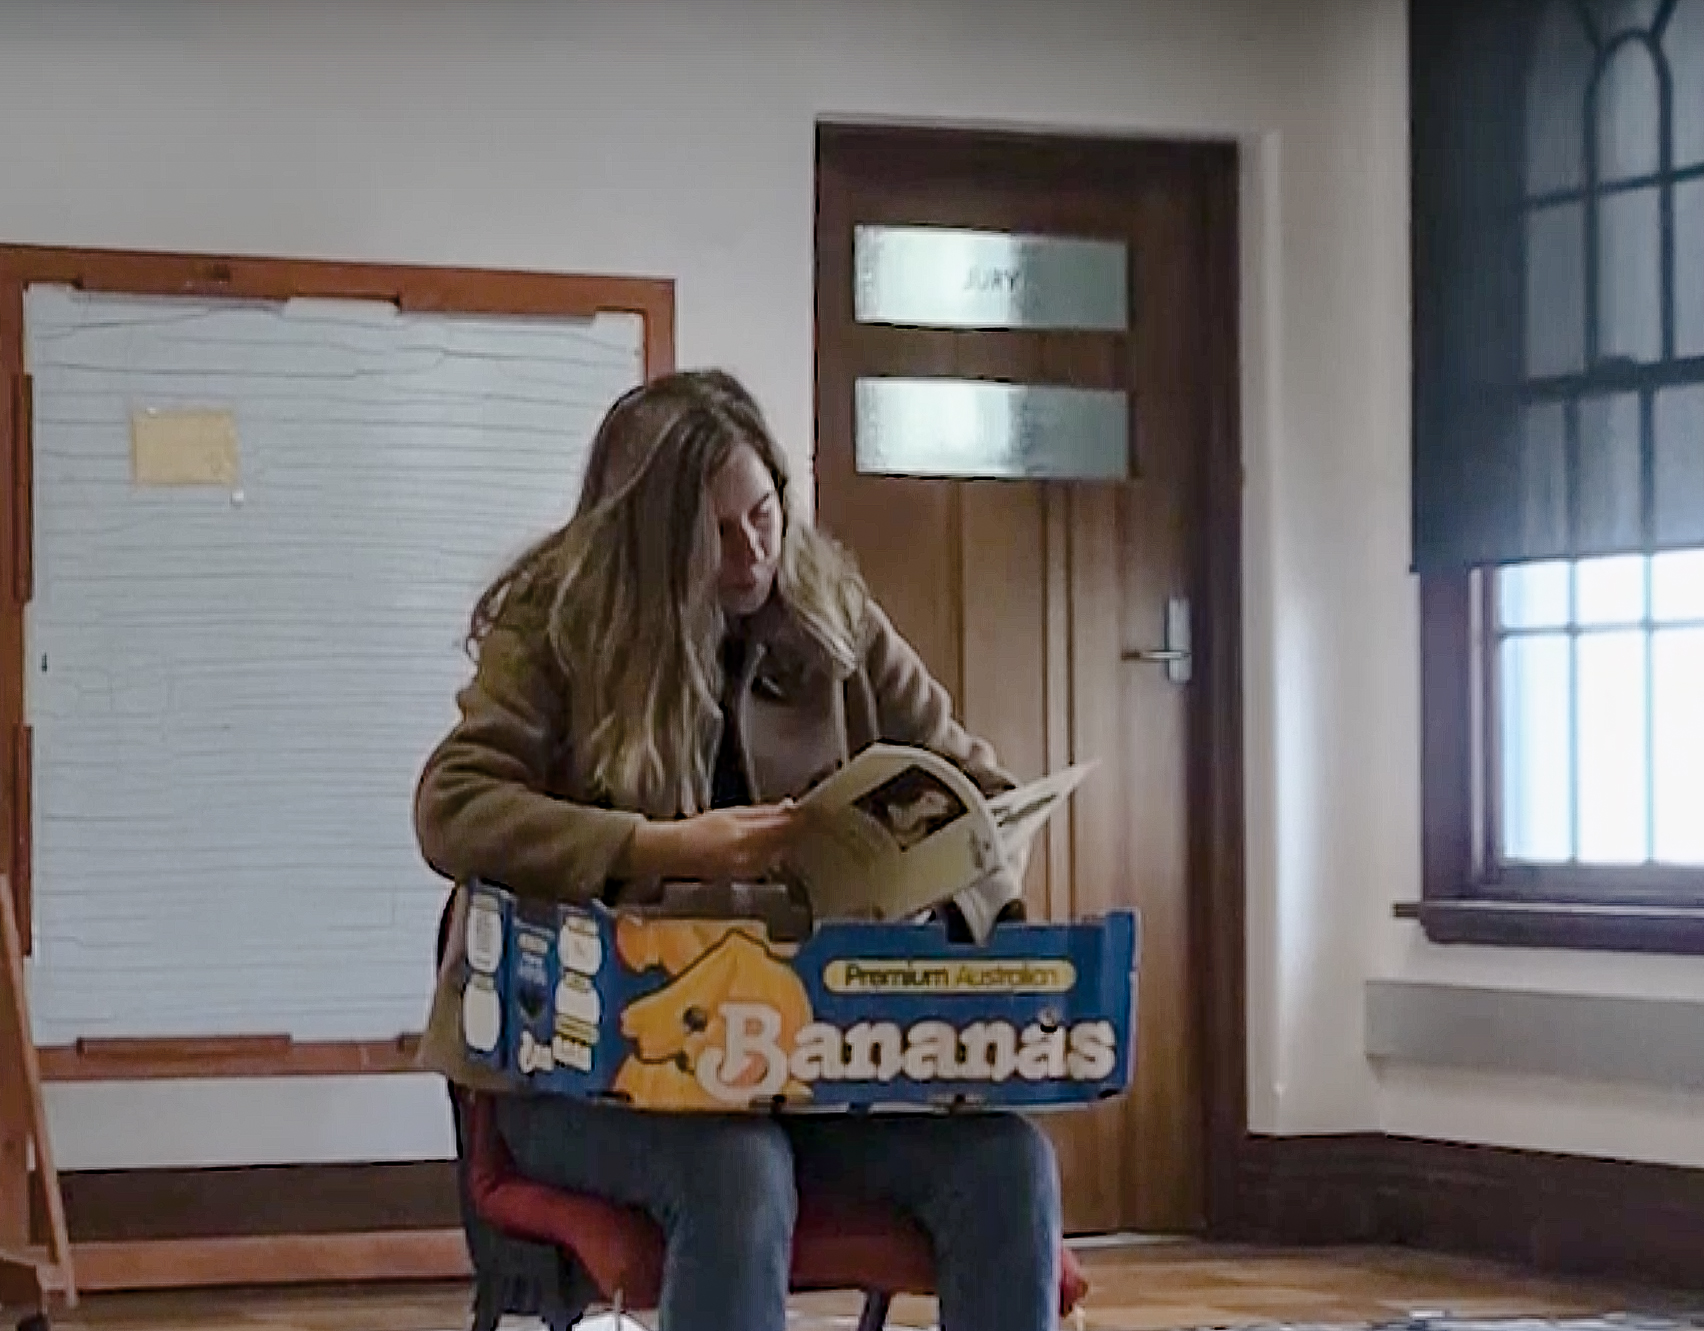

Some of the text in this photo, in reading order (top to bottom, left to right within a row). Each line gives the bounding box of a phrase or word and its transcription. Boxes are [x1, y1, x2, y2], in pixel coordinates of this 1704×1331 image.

[963, 267, 1021, 293] JURY
[844, 962, 1059, 987] Premium Australian
[699, 1003, 1117, 1099] Bananas
